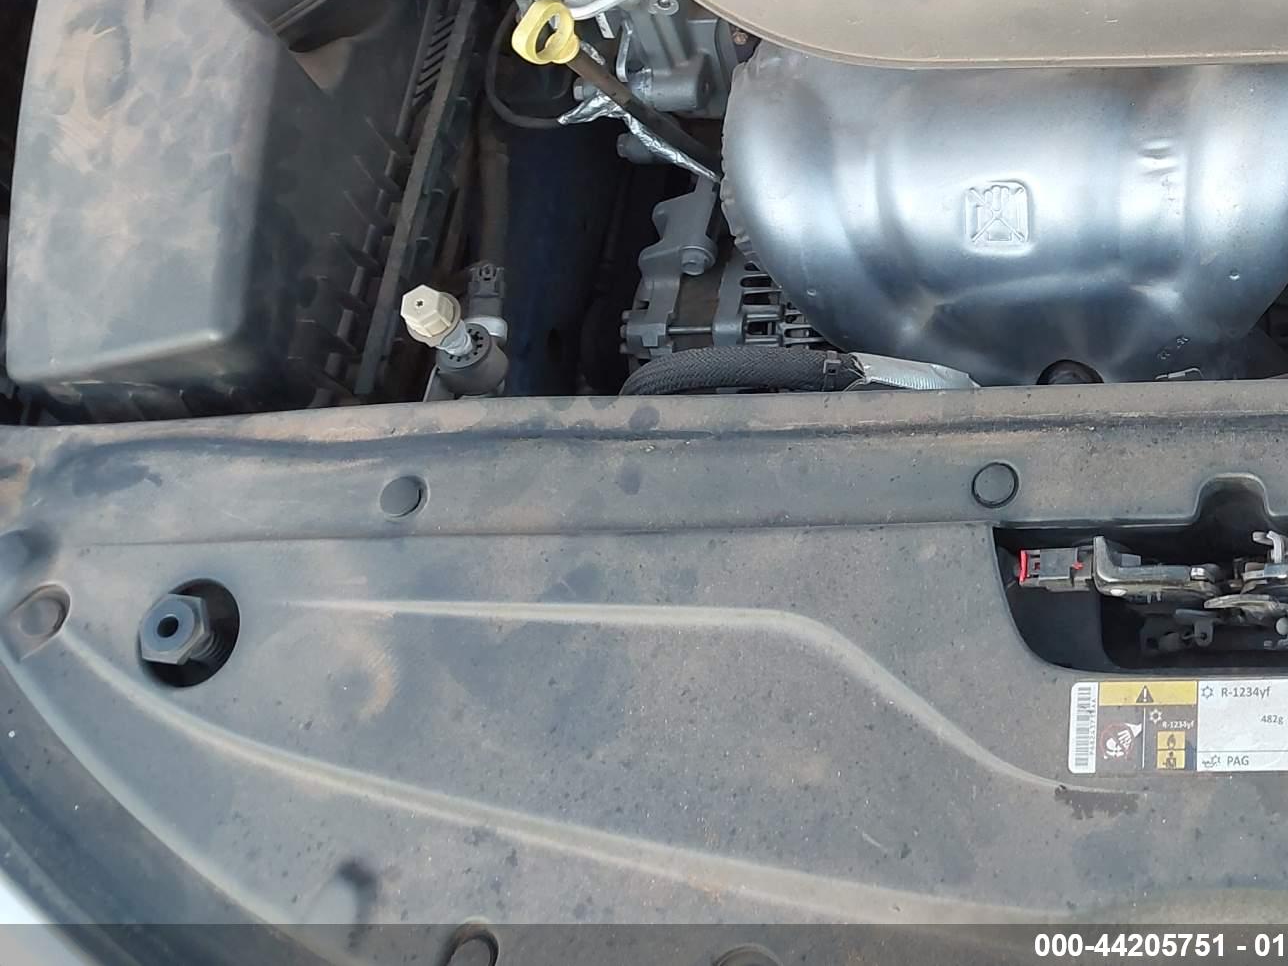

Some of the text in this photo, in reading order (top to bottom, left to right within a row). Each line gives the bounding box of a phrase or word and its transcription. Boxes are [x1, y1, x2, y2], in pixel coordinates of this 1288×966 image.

[1221, 686, 1271, 701] R-1234yf
[1260, 714, 1284, 725] 482g
[1227, 755, 1249, 766] PAG
